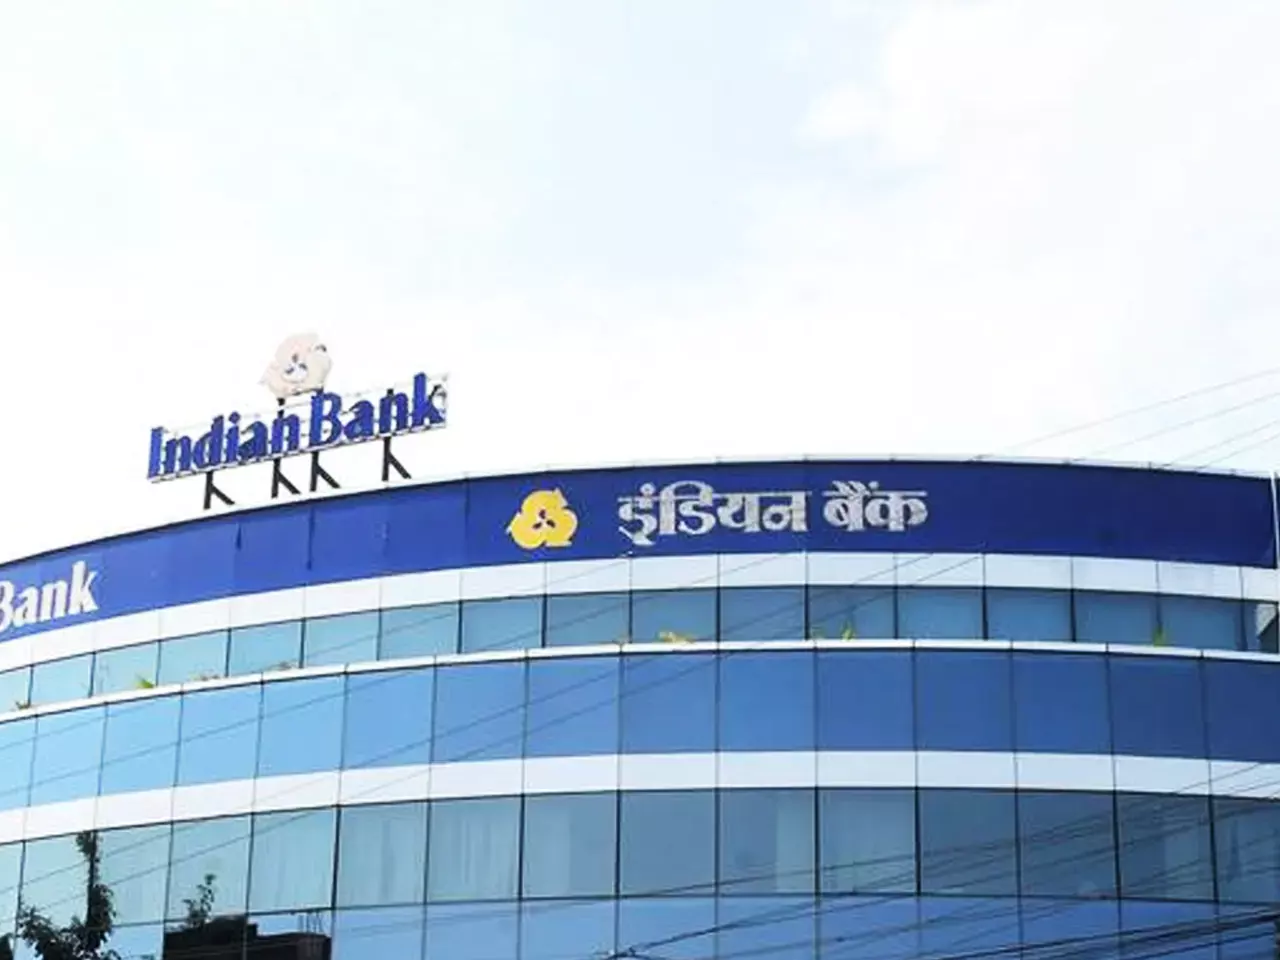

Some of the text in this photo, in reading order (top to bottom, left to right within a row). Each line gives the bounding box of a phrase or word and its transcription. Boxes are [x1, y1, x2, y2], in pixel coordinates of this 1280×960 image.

[147, 371, 448, 480] Indian Bank
[618, 480, 928, 546] इंडियन बैंक
